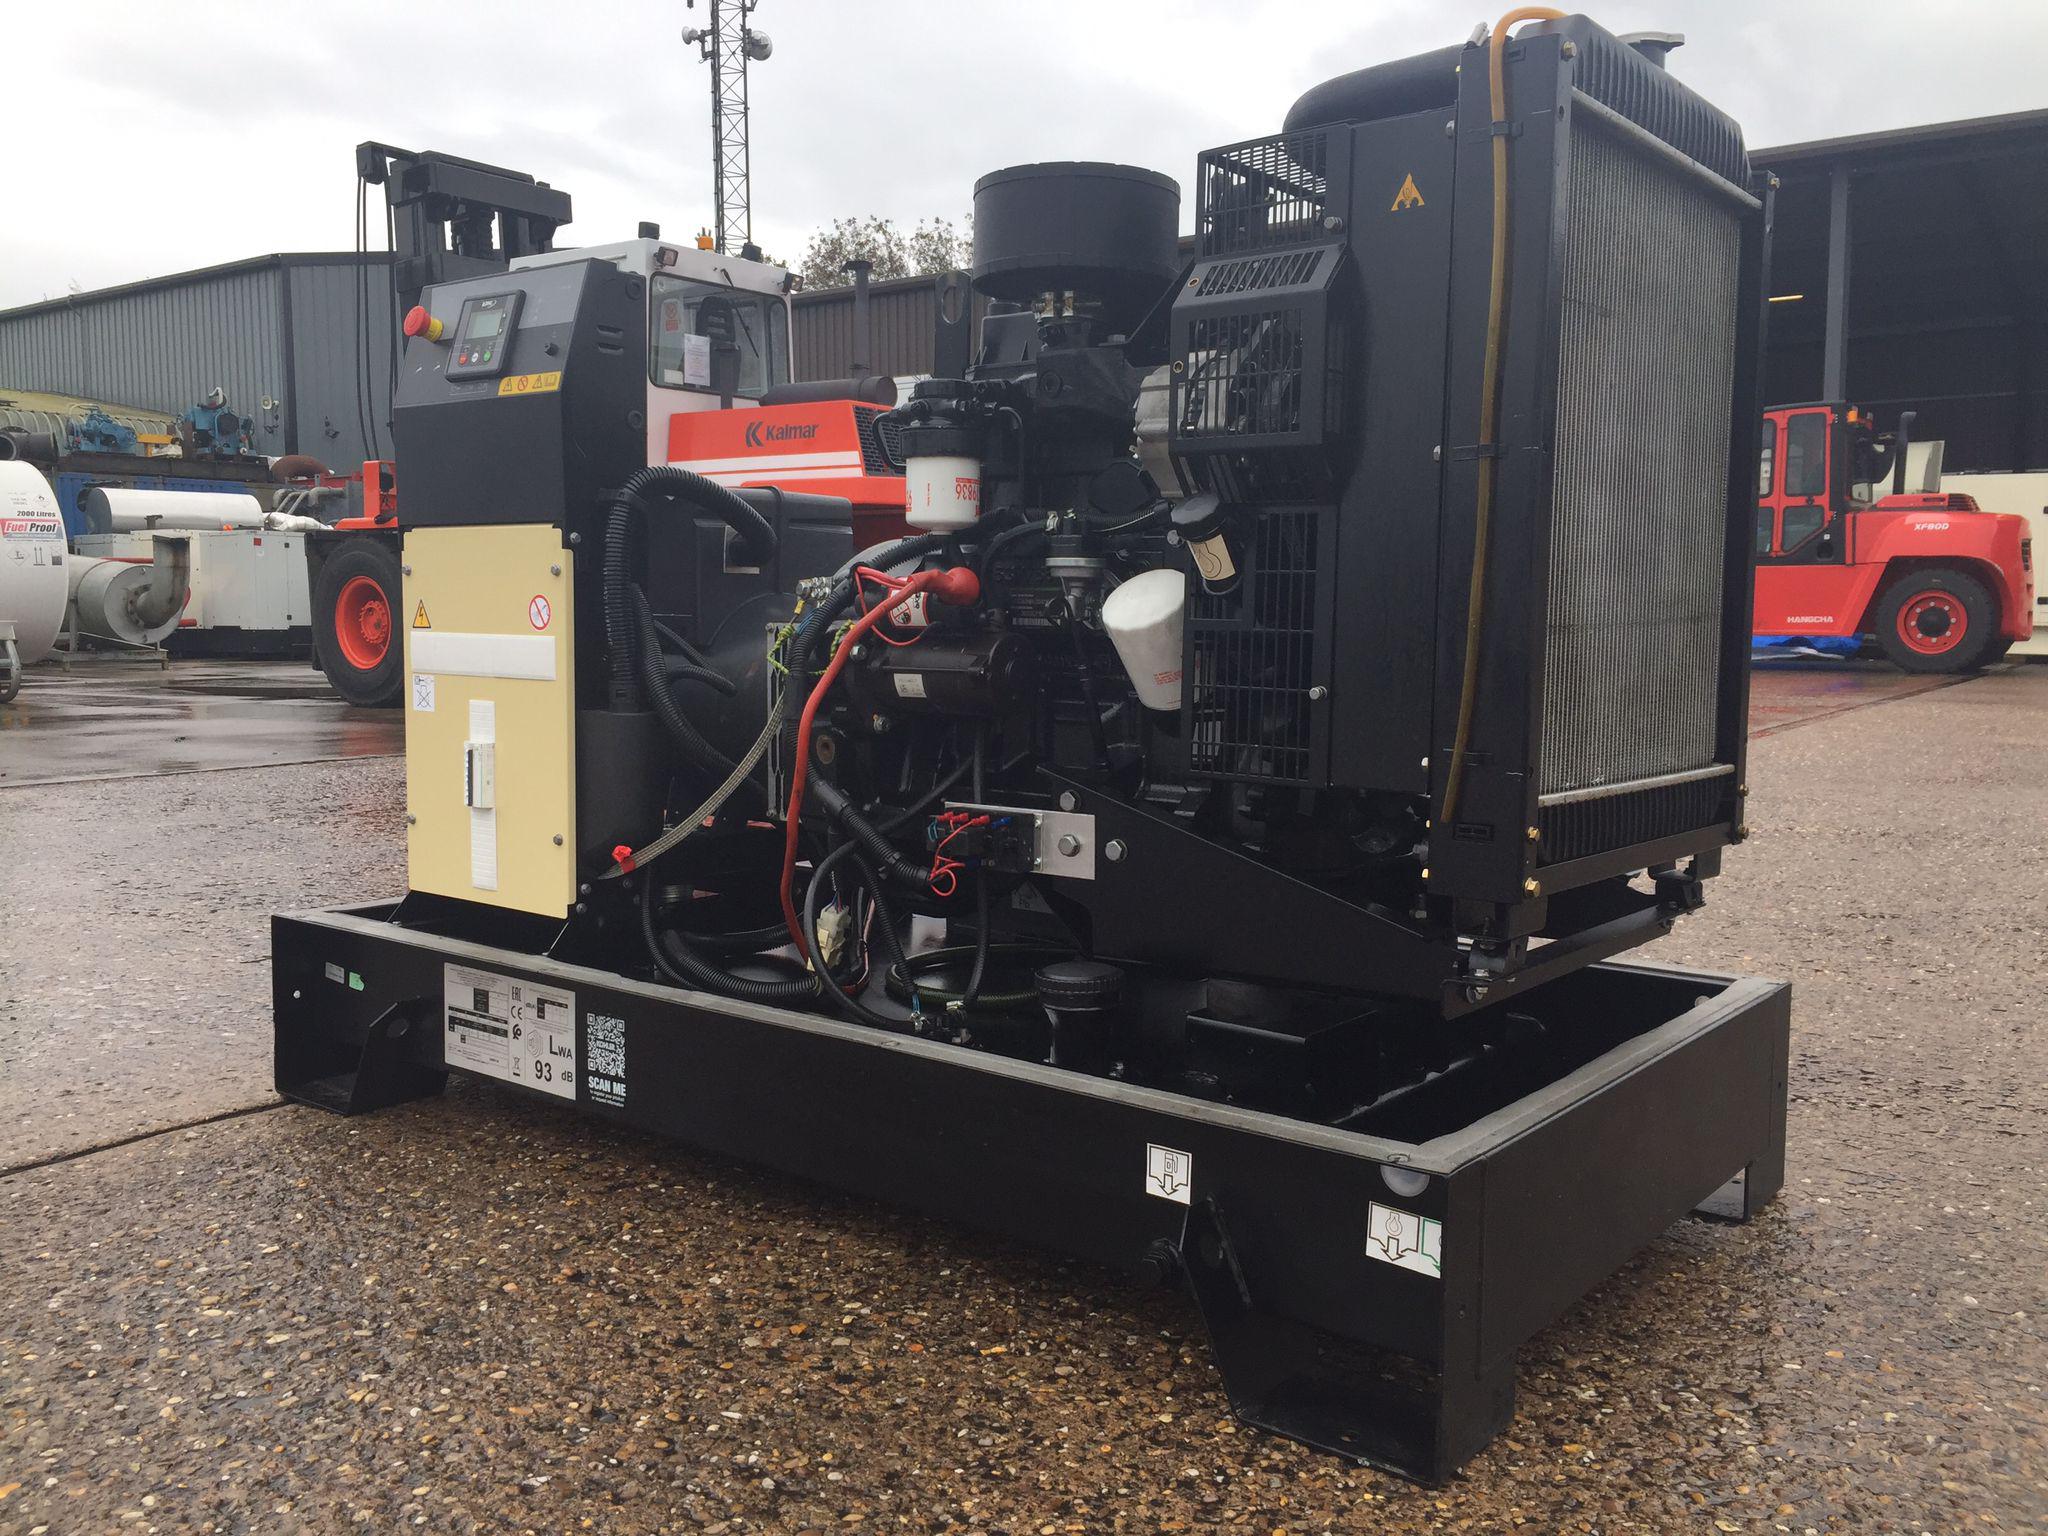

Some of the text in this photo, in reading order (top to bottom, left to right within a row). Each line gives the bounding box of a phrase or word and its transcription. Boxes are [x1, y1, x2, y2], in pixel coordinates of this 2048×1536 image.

[766, 424, 819, 441] Kalmar
[6, 522, 57, 533] Fuel Proof
[535, 1060, 574, 1082] 93 dB
[588, 1075, 627, 1097] SCAN ME
